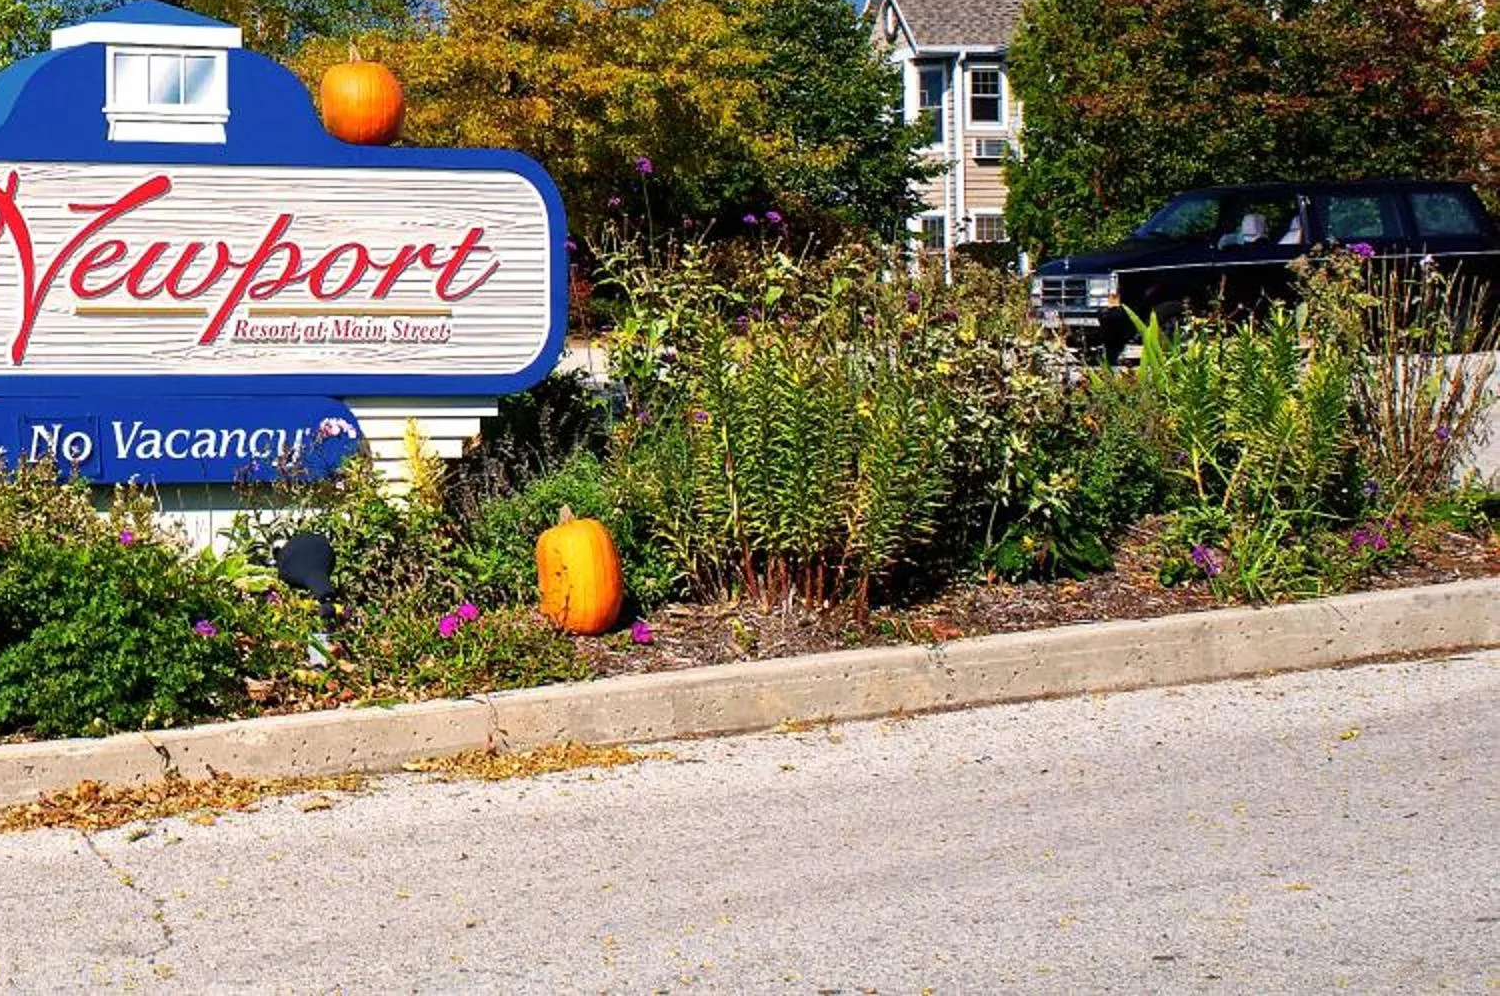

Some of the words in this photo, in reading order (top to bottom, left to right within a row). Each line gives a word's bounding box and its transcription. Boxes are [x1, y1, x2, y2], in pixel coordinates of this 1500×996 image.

[234, 319, 297, 341] Resort
[303, 321, 327, 341] at
[333, 319, 384, 341] Main
[391, 319, 450, 341] Street
[27, 423, 93, 463] No
[111, 420, 304, 466] Vacancy
